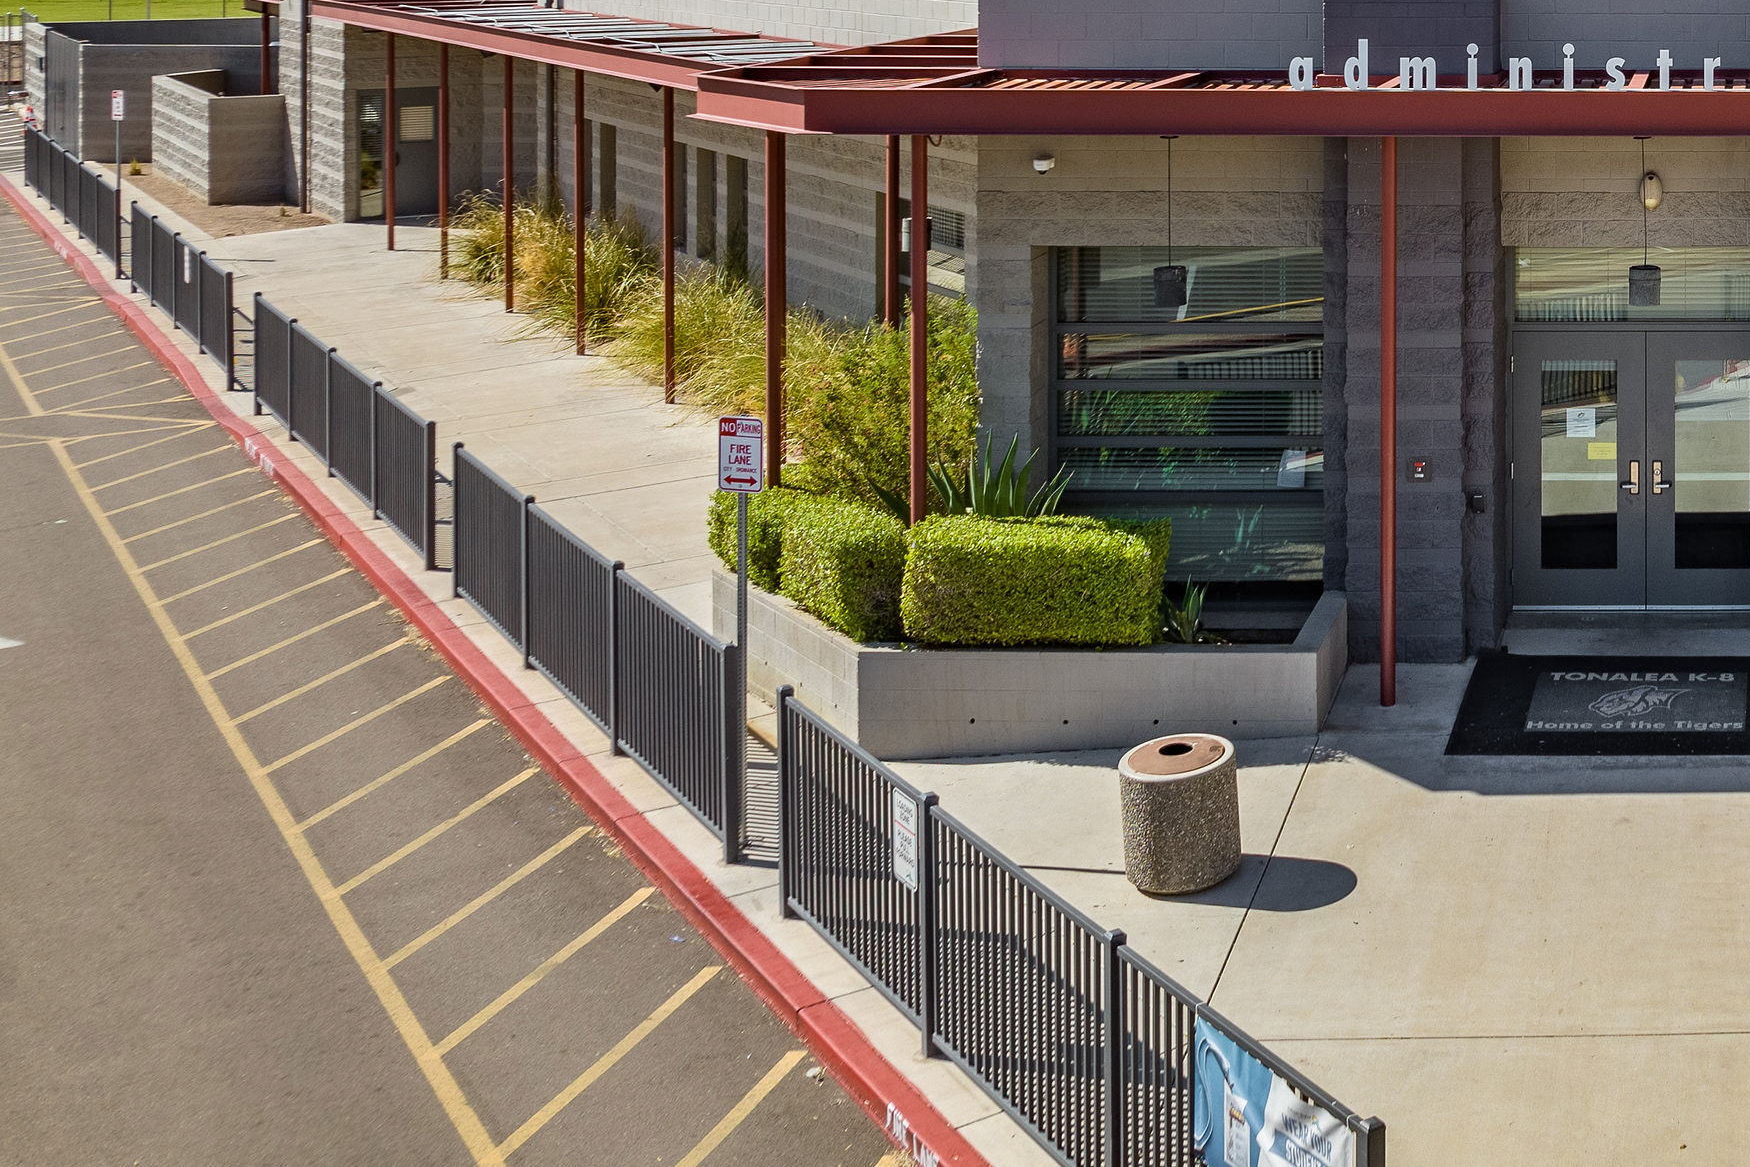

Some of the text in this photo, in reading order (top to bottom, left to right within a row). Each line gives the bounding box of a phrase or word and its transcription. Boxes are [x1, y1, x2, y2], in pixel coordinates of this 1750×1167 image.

[721, 422, 761, 434] NO PARKING
[730, 444, 752, 454] FIRE
[728, 454, 752, 465] LANE
[1550, 672, 1735, 682] TONALEA K-8
[1526, 720, 1744, 731] Home of the Tigers
[1281, 1112, 1308, 1144] WEAR
[1310, 1132, 1332, 1162] YOUR
[1285, 1138, 1321, 1167] STUDE
